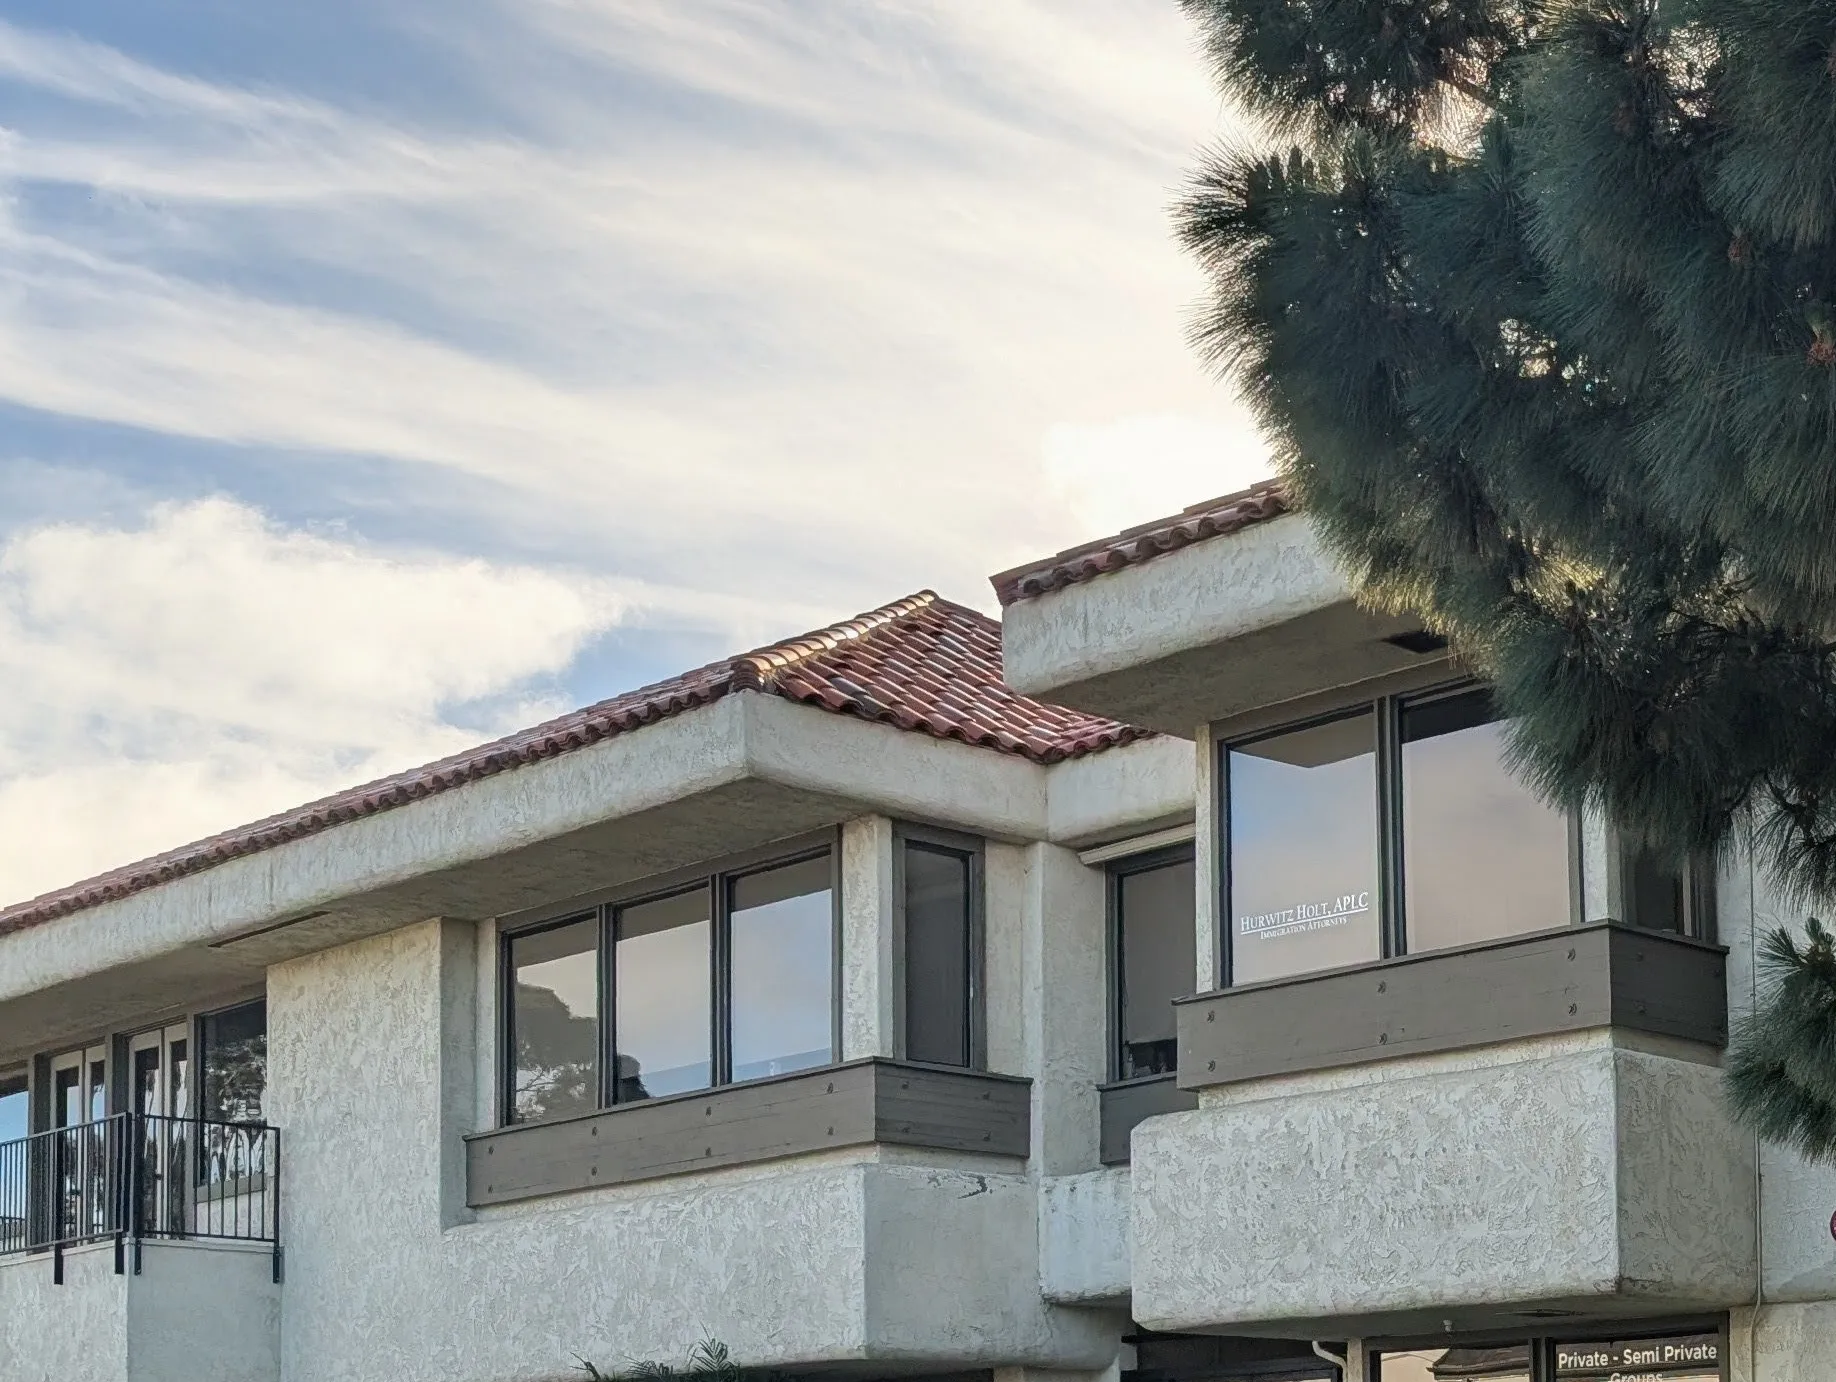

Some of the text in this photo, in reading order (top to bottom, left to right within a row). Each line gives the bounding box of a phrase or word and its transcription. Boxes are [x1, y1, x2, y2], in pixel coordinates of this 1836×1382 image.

[1240, 892, 1369, 932] HURWITZ HOLT, APLC
[1260, 922, 1306, 940] IMMIGRATION
[1558, 1350, 1609, 1369] Private
[1623, 1346, 1660, 1365] Semi
[1664, 1344, 1717, 1362] Private
